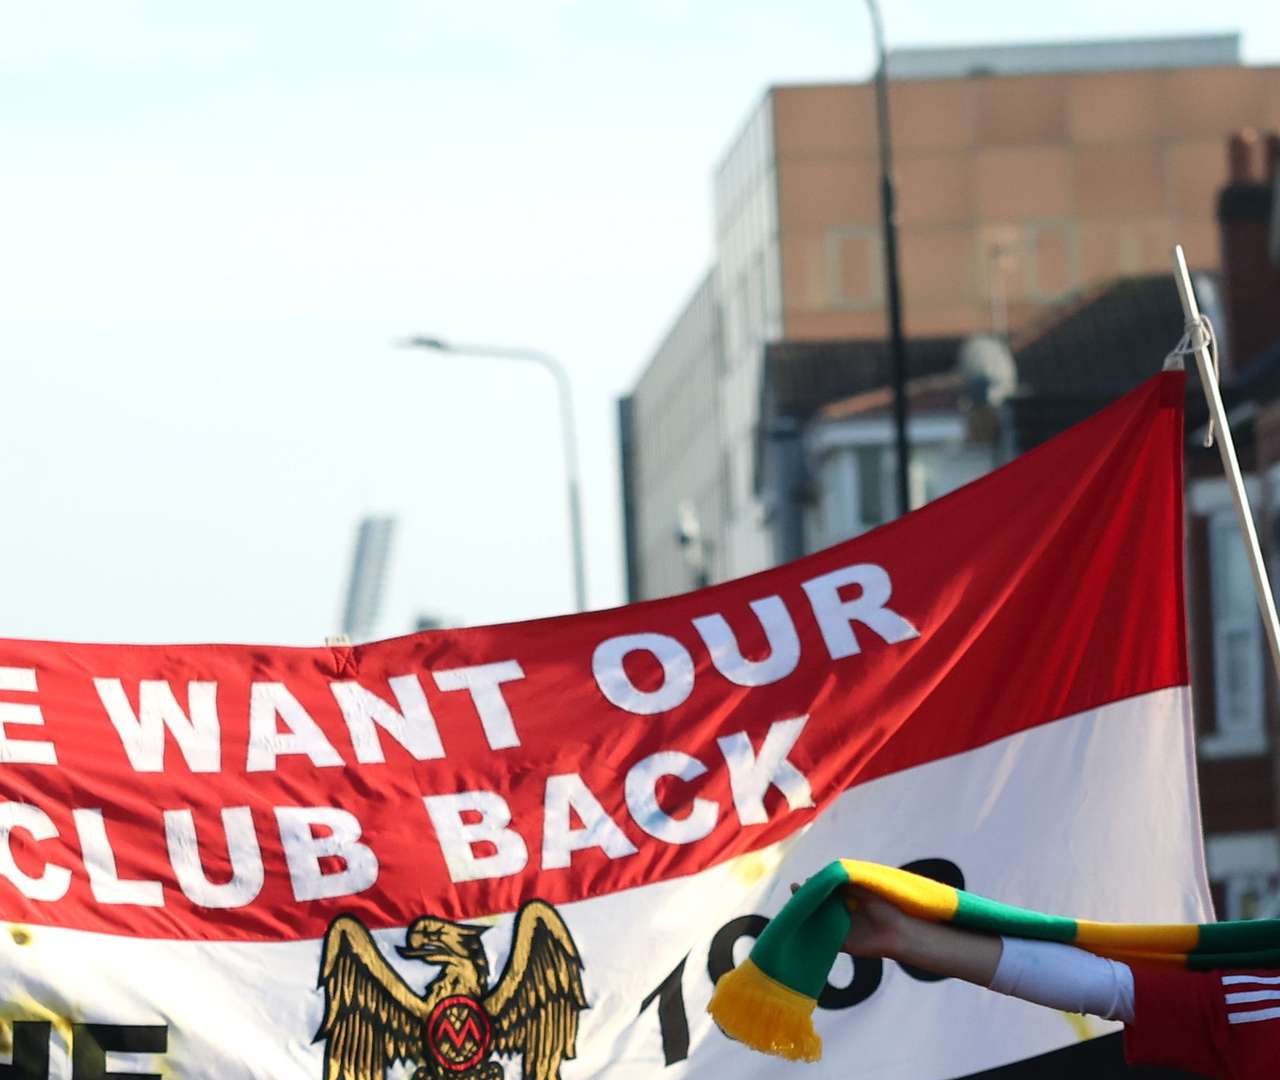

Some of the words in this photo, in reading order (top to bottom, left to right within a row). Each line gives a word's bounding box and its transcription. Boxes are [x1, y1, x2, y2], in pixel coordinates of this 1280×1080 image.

[94, 659, 524, 773] WANT
[591, 562, 920, 715] OUR
[422, 713, 815, 883] BACK
